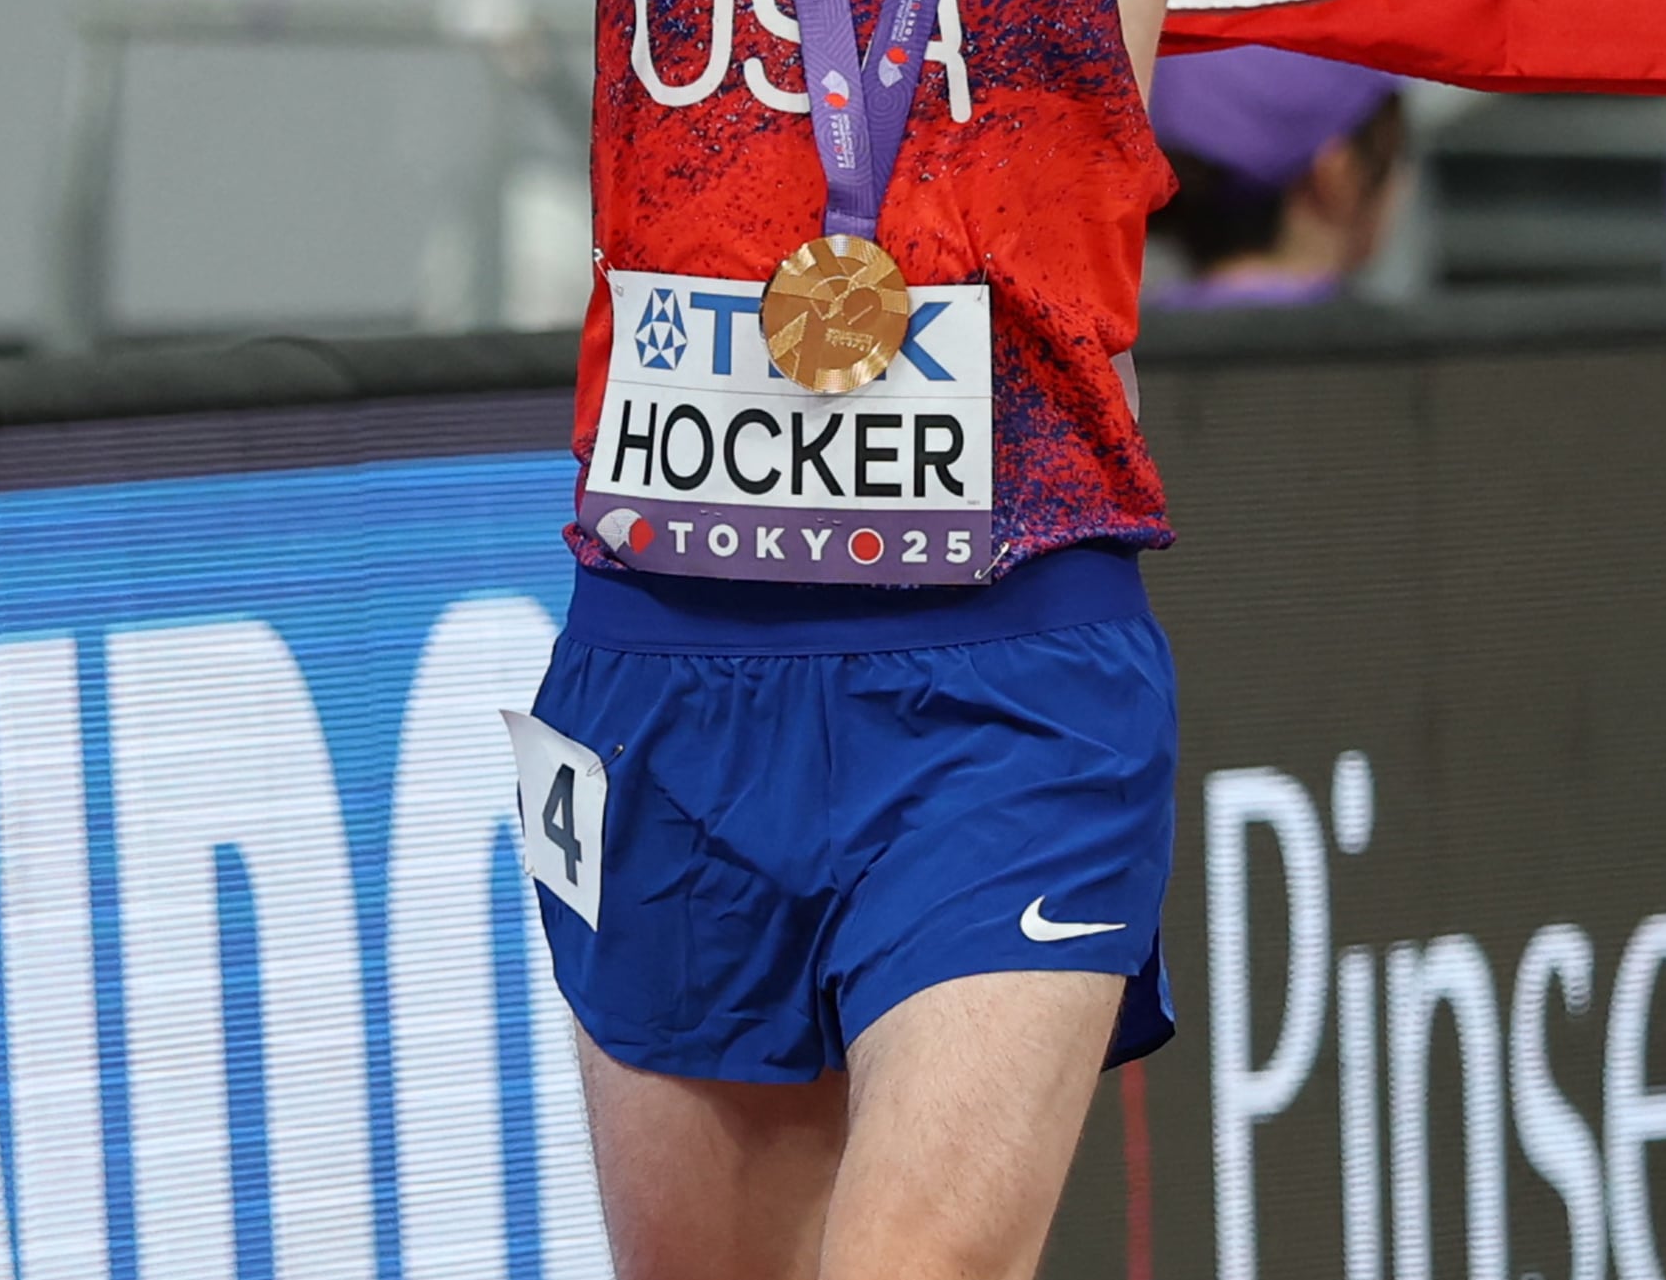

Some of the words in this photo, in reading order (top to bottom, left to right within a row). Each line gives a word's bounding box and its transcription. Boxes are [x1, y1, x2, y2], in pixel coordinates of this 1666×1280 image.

[689, 290, 957, 382] TK
[610, 399, 965, 499] HOCKER
[541, 757, 583, 887] 4
